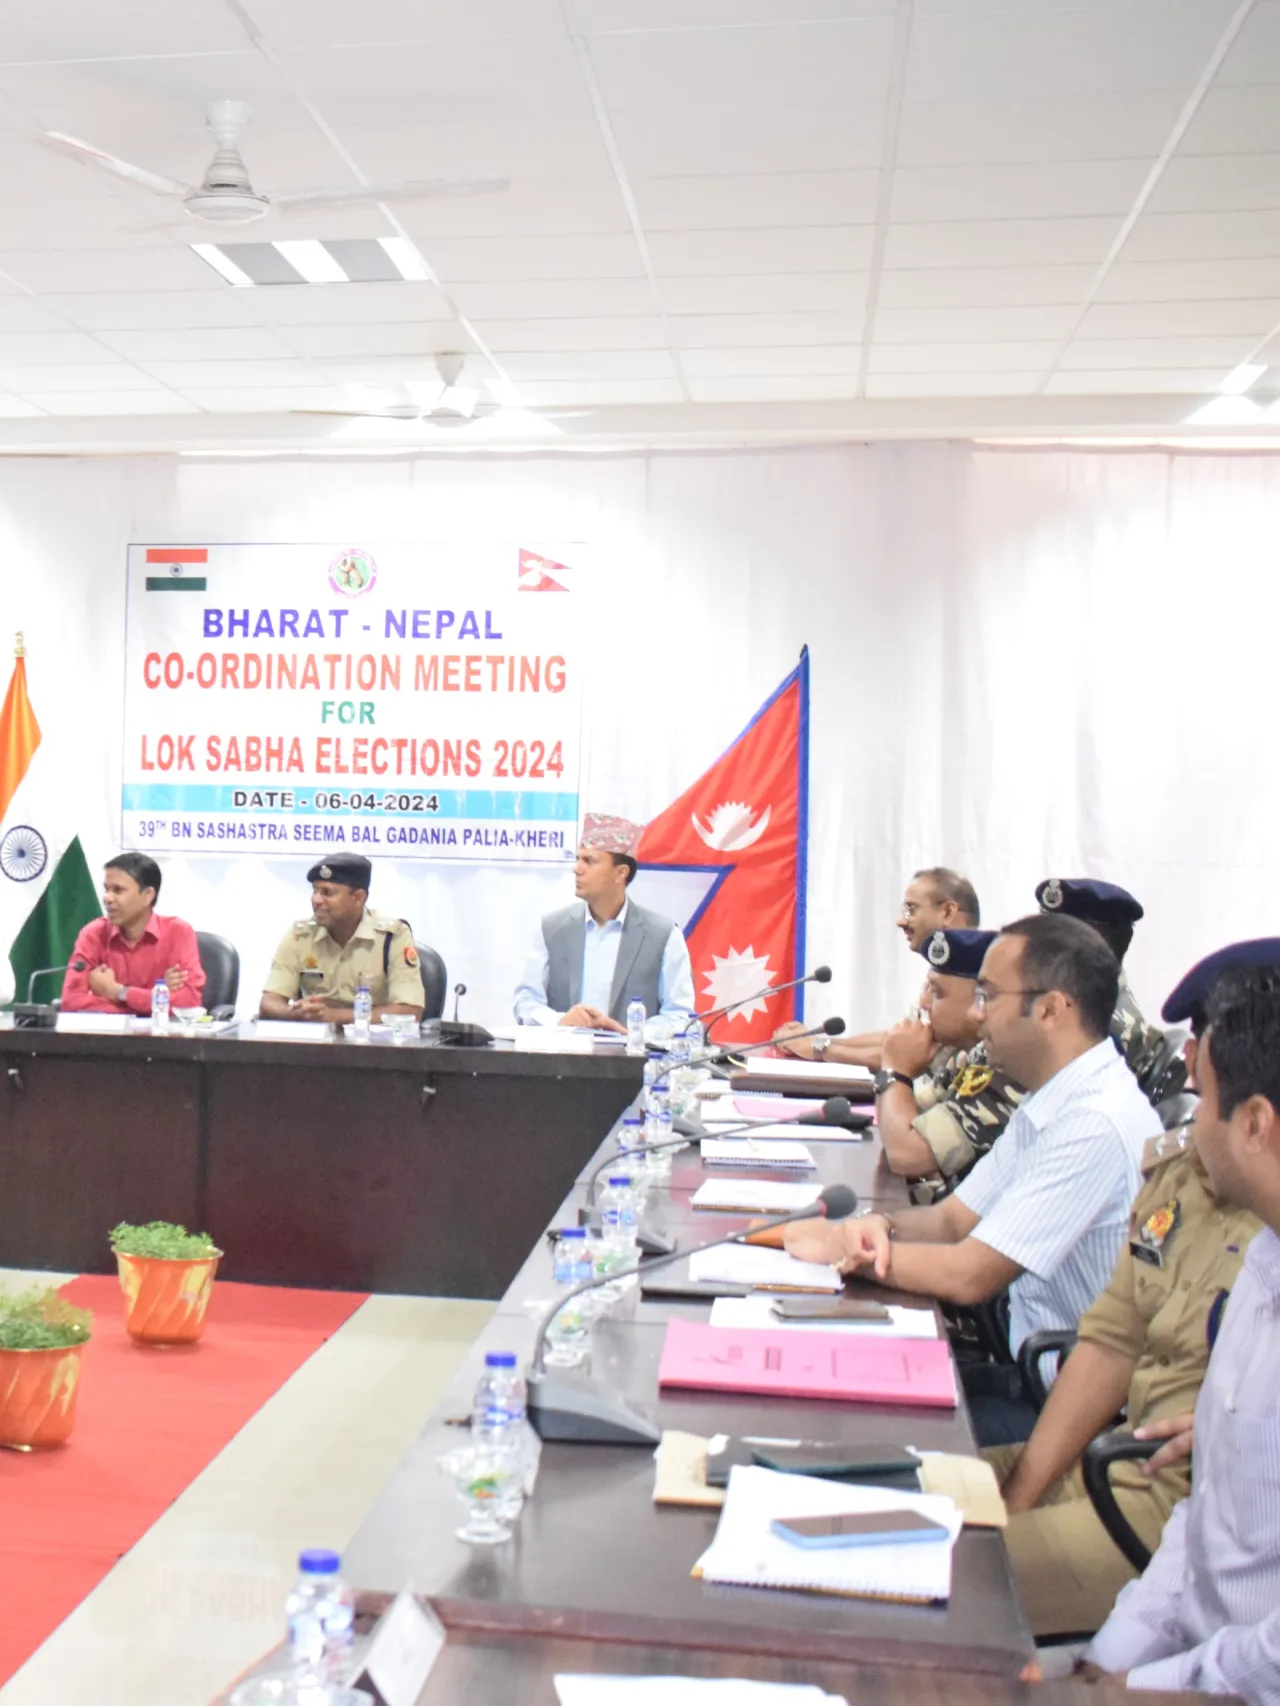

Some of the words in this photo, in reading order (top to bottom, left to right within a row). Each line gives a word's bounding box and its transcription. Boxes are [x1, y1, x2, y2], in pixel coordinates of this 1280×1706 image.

[203, 609, 348, 638] BHARAT
[385, 610, 502, 639] NEPAL
[144, 652, 400, 690] CO-ORDINATION
[415, 655, 565, 693] MEETING
[322, 701, 375, 724] FOR
[142, 735, 195, 771] LOK
[206, 735, 304, 772] SABHA
[316, 737, 481, 777] ELECTIONS
[494, 740, 563, 778] 2024
[234, 791, 293, 808] DATE
[314, 793, 438, 811] 06-04-2024
[172, 822, 191, 837] BN
[197, 822, 287, 839] SASHASTRA
[294, 824, 345, 841] SEEMA
[352, 826, 380, 843] BAL
[387, 827, 457, 845] GADANIA
[464, 829, 563, 847] PALIA-KHERI
